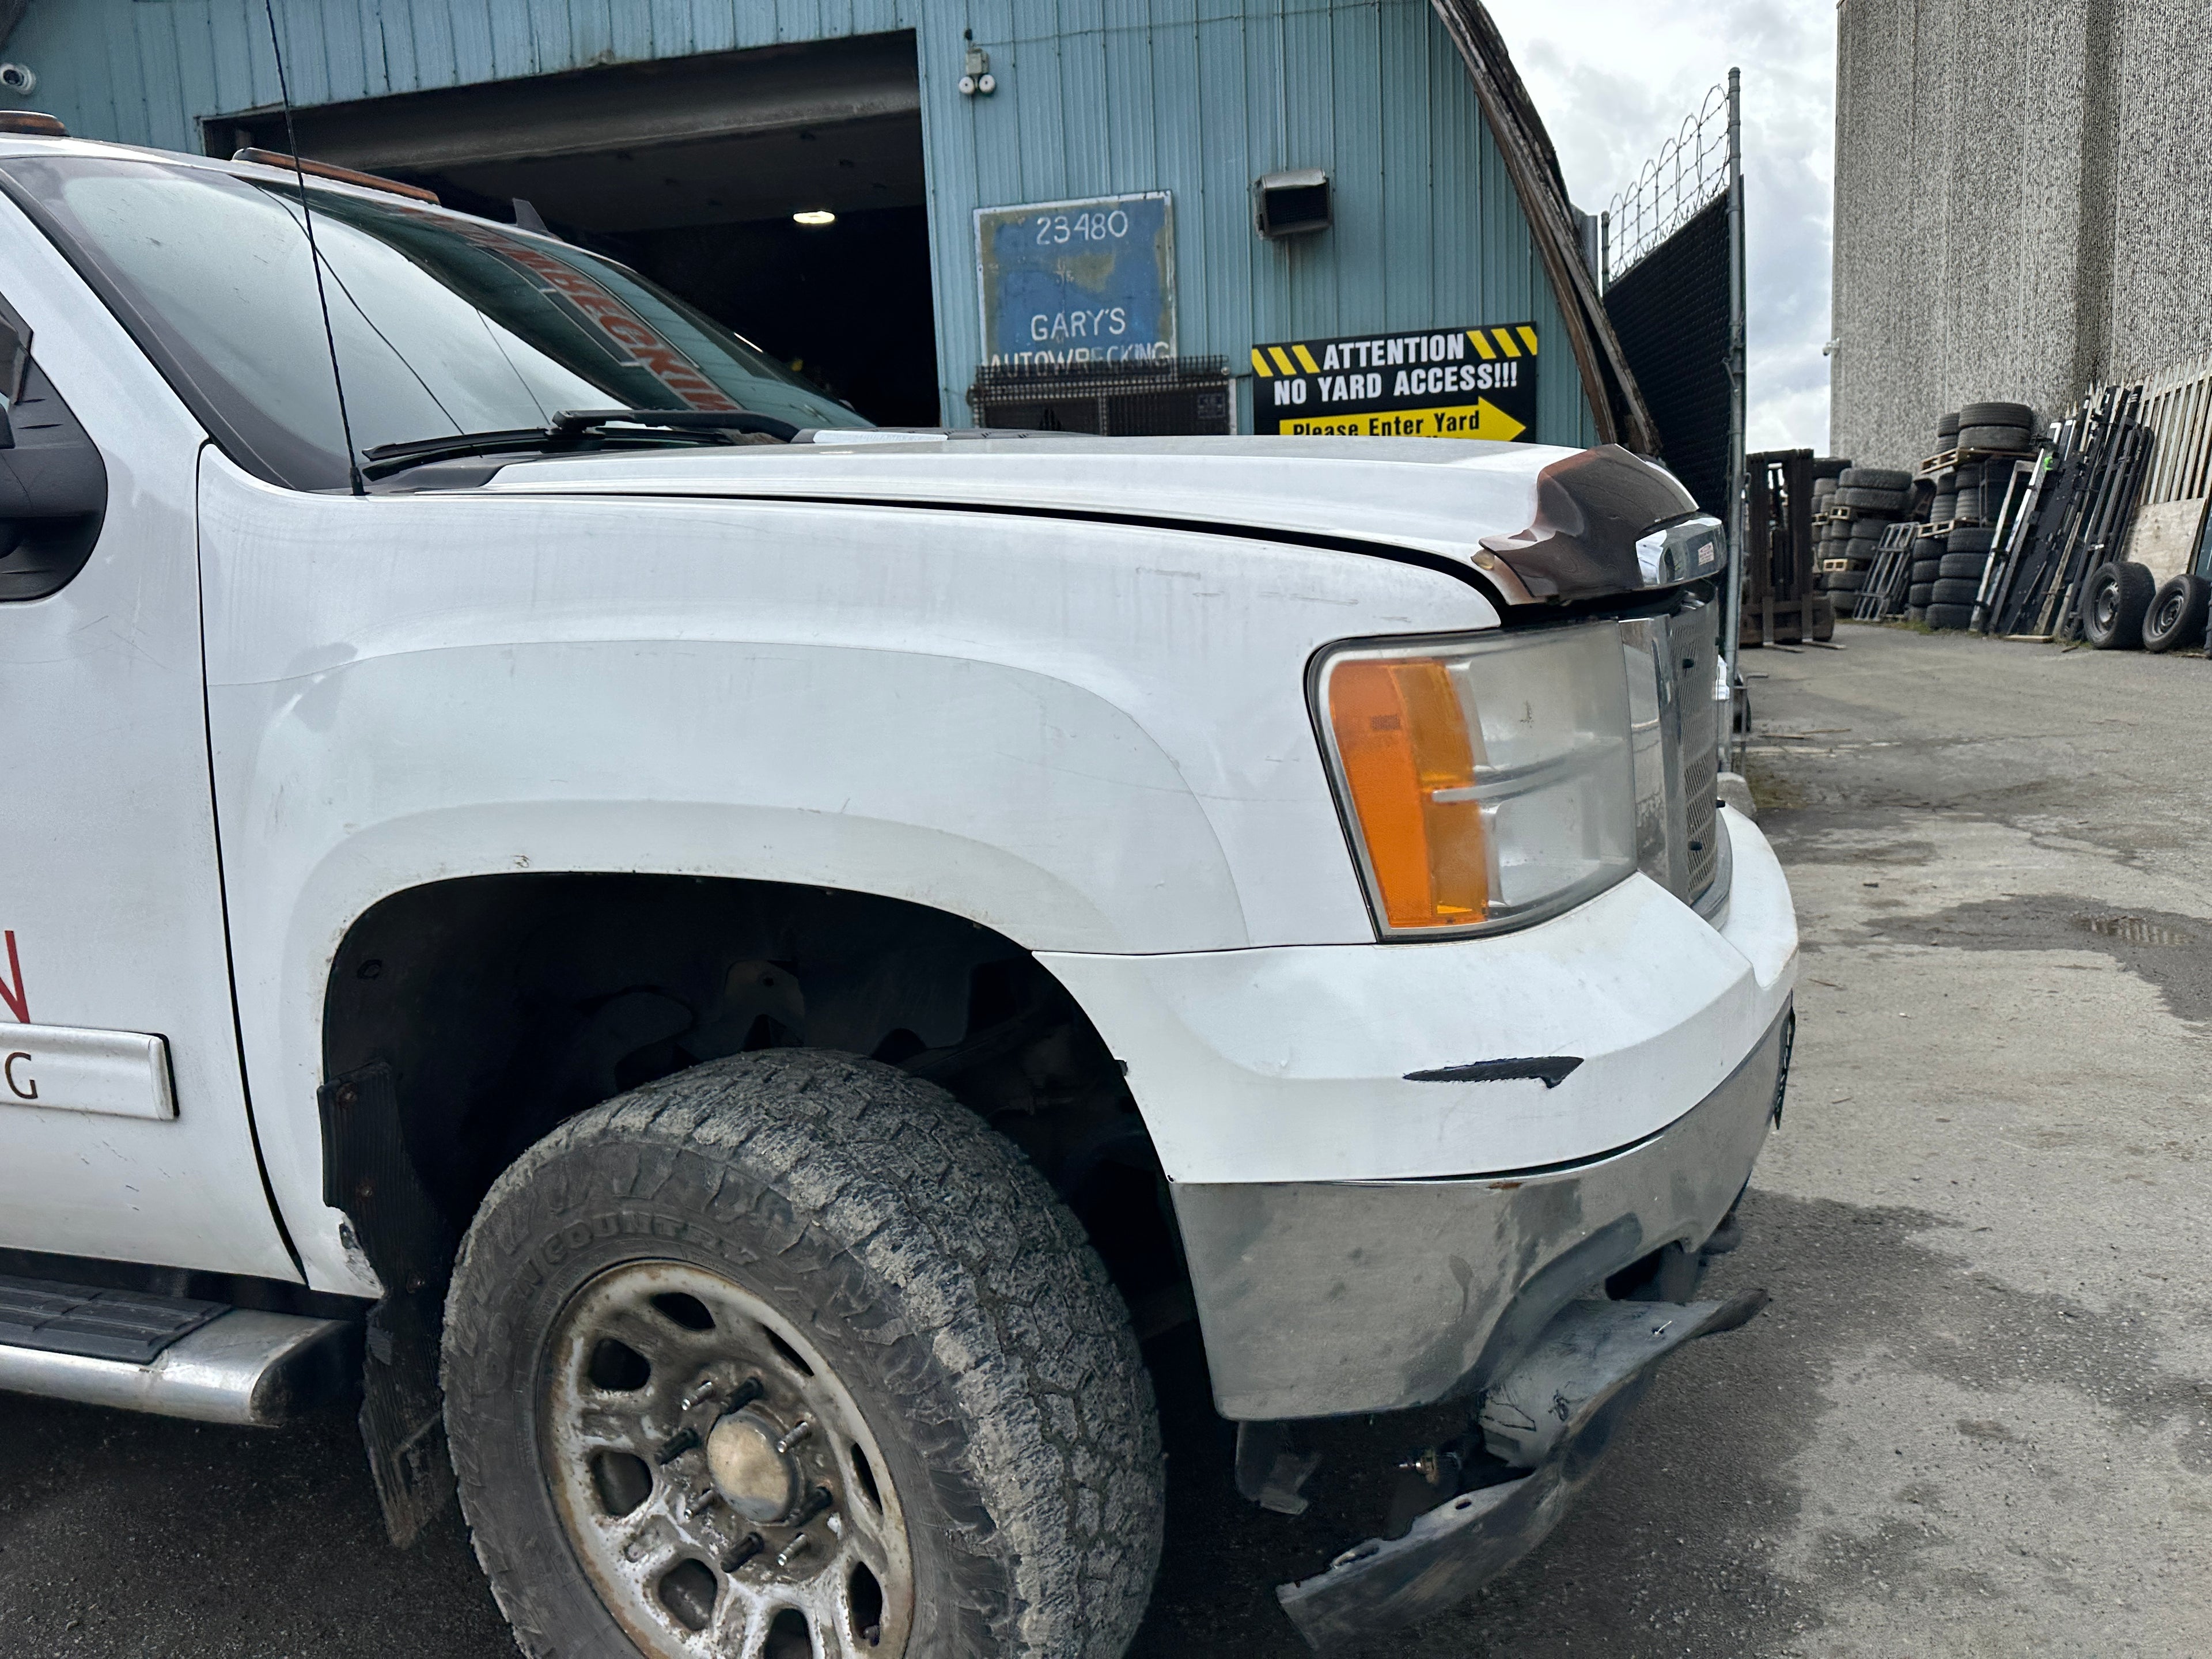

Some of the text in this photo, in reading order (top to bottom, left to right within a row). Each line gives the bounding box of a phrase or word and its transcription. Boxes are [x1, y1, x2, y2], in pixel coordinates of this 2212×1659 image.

[1036, 210, 1128, 245] 23480
[1031, 308, 1126, 341] GARY'S
[1323, 334, 1464, 370] ATTENTION
[1274, 361, 1518, 406] NO YARD ACCESS!!!
[1293, 410, 1479, 436] Please Enter Yard
[5, 1052, 38, 1099] G
